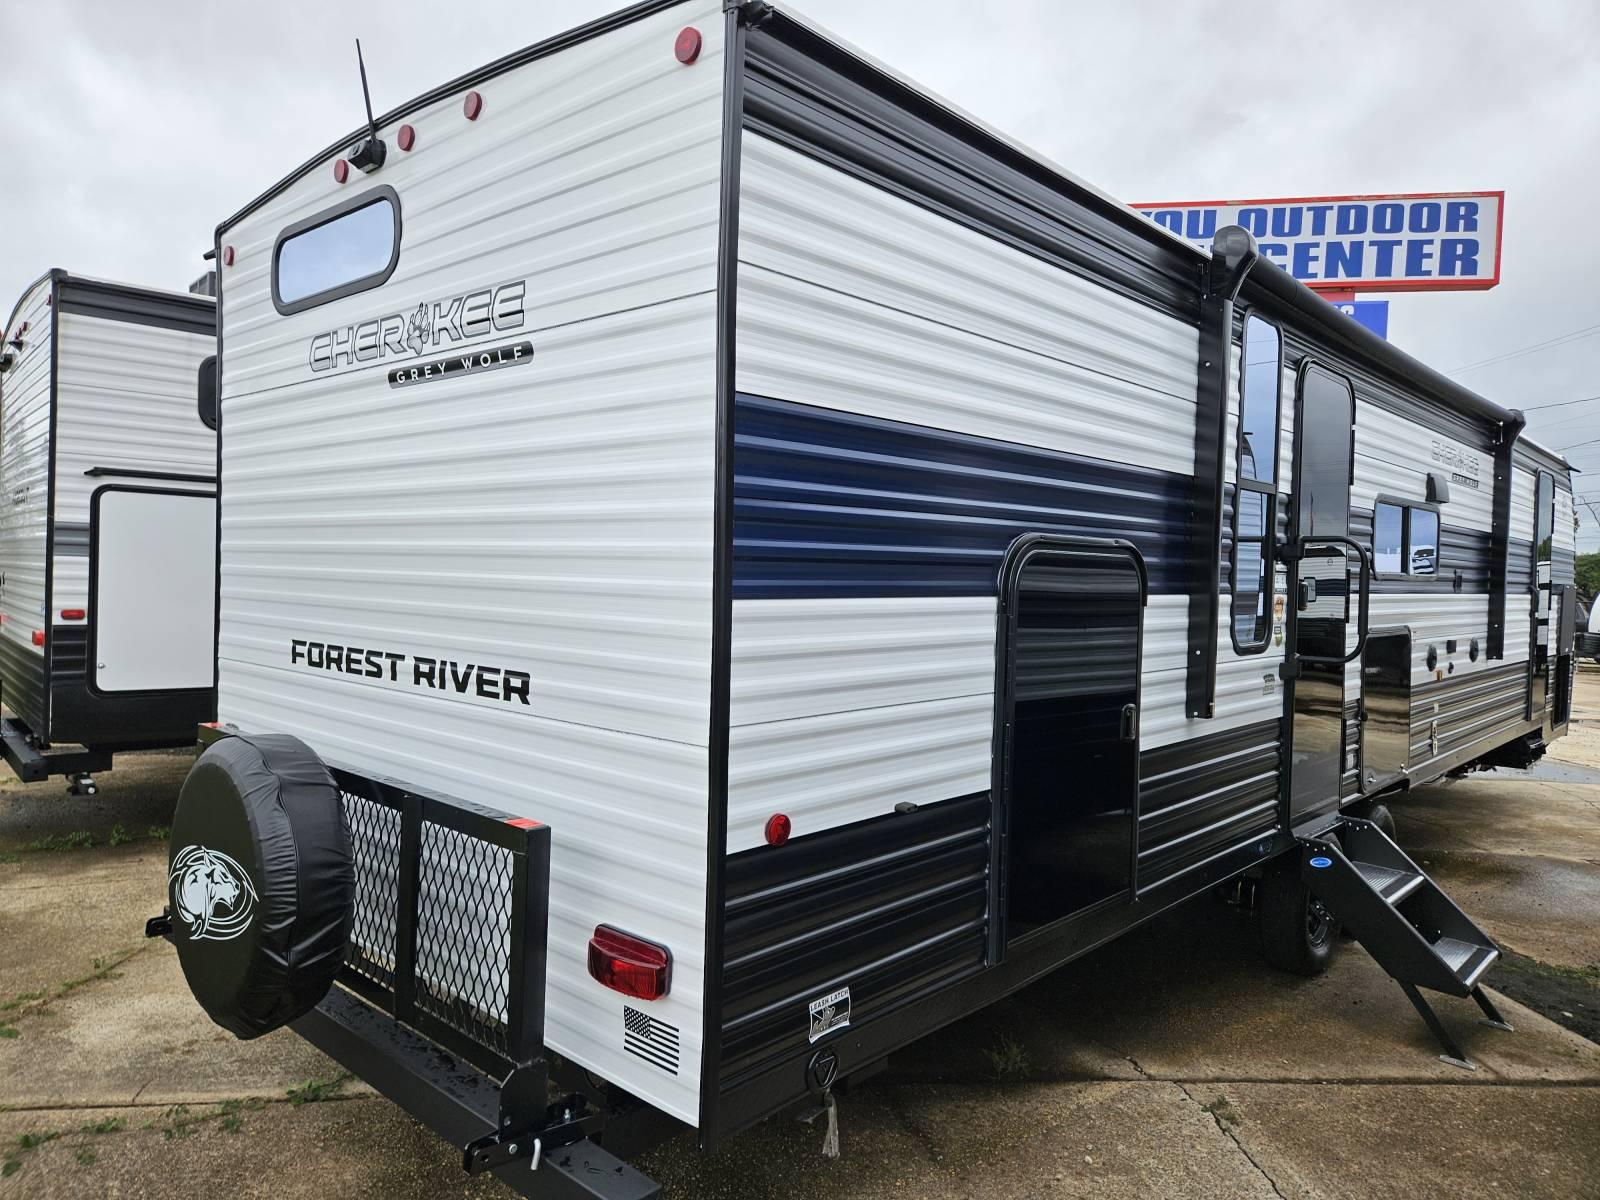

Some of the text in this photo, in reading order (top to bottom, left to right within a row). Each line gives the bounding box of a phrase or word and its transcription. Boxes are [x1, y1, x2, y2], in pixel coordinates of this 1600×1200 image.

[1141, 201, 1479, 239] OU OUTDOOR
[396, 345, 524, 384] GREY WOLF
[291, 639, 531, 706] FOREST RIVER
[810, 988, 849, 1012] LEASH LATCH
